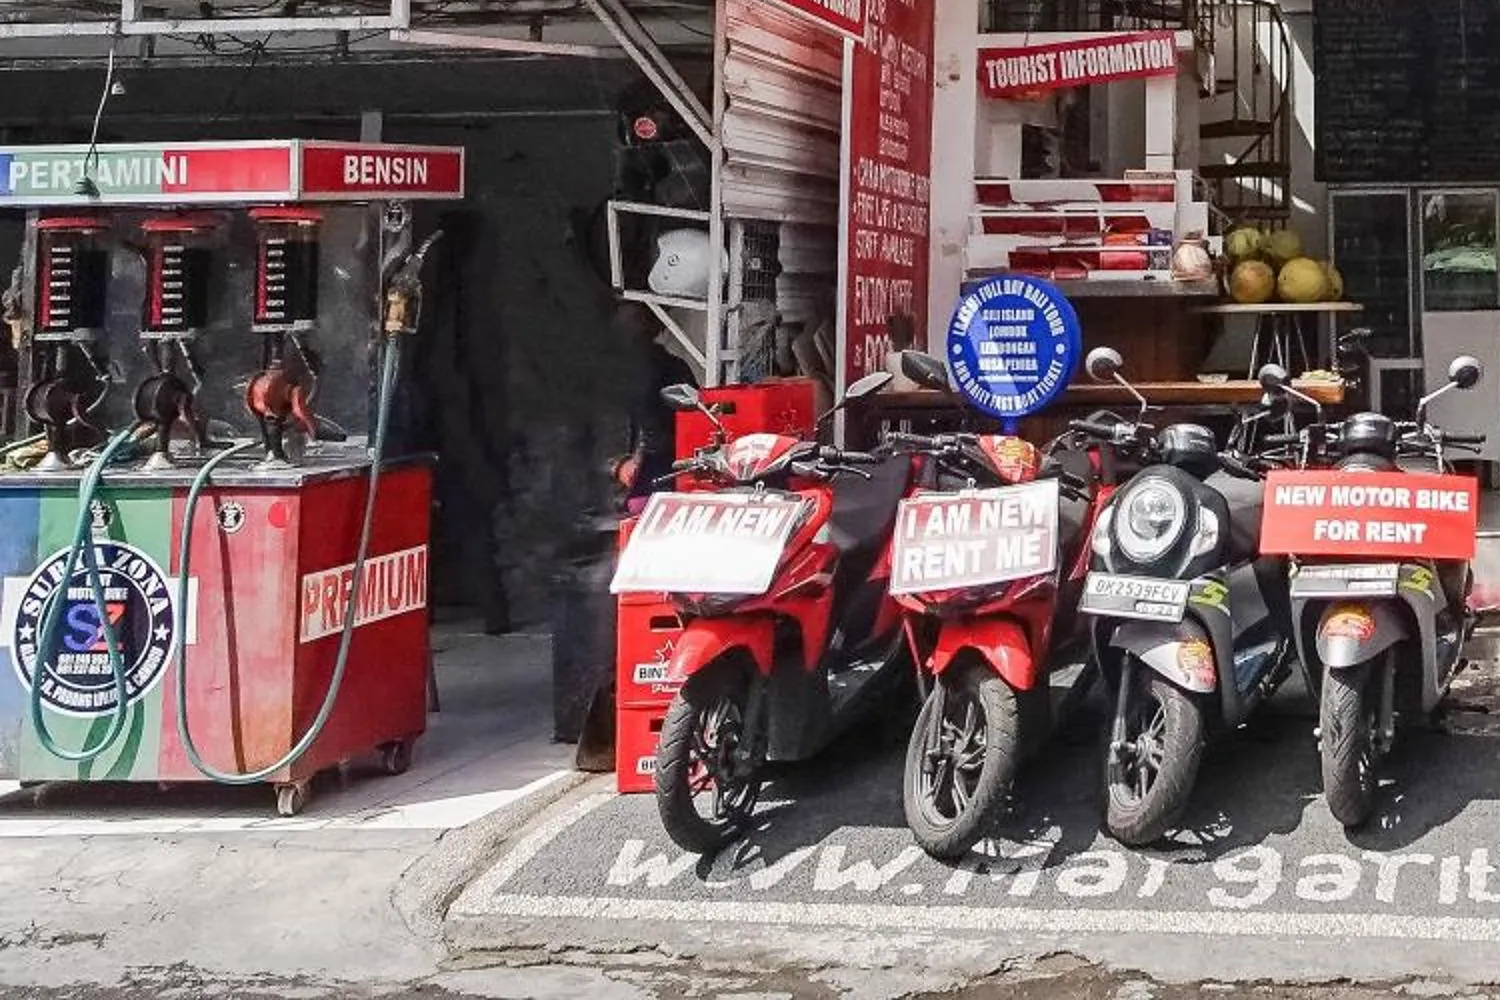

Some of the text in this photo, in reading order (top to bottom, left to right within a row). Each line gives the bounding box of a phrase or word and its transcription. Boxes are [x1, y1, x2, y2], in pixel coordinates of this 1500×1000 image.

[985, 37, 1175, 90] TOURIST INFORMATION
[8, 154, 429, 191] PERTAMINI BENSIN
[905, 494, 1048, 537] I AM NEW
[1275, 485, 1470, 512] NEW MOTOR BIKE
[646, 504, 785, 538] I AM NEW
[1313, 522, 1428, 545] FOR RENT
[901, 531, 1043, 582] RENT ME
[111, 551, 171, 617] ZONA
[302, 549, 428, 631] PREMIUM
